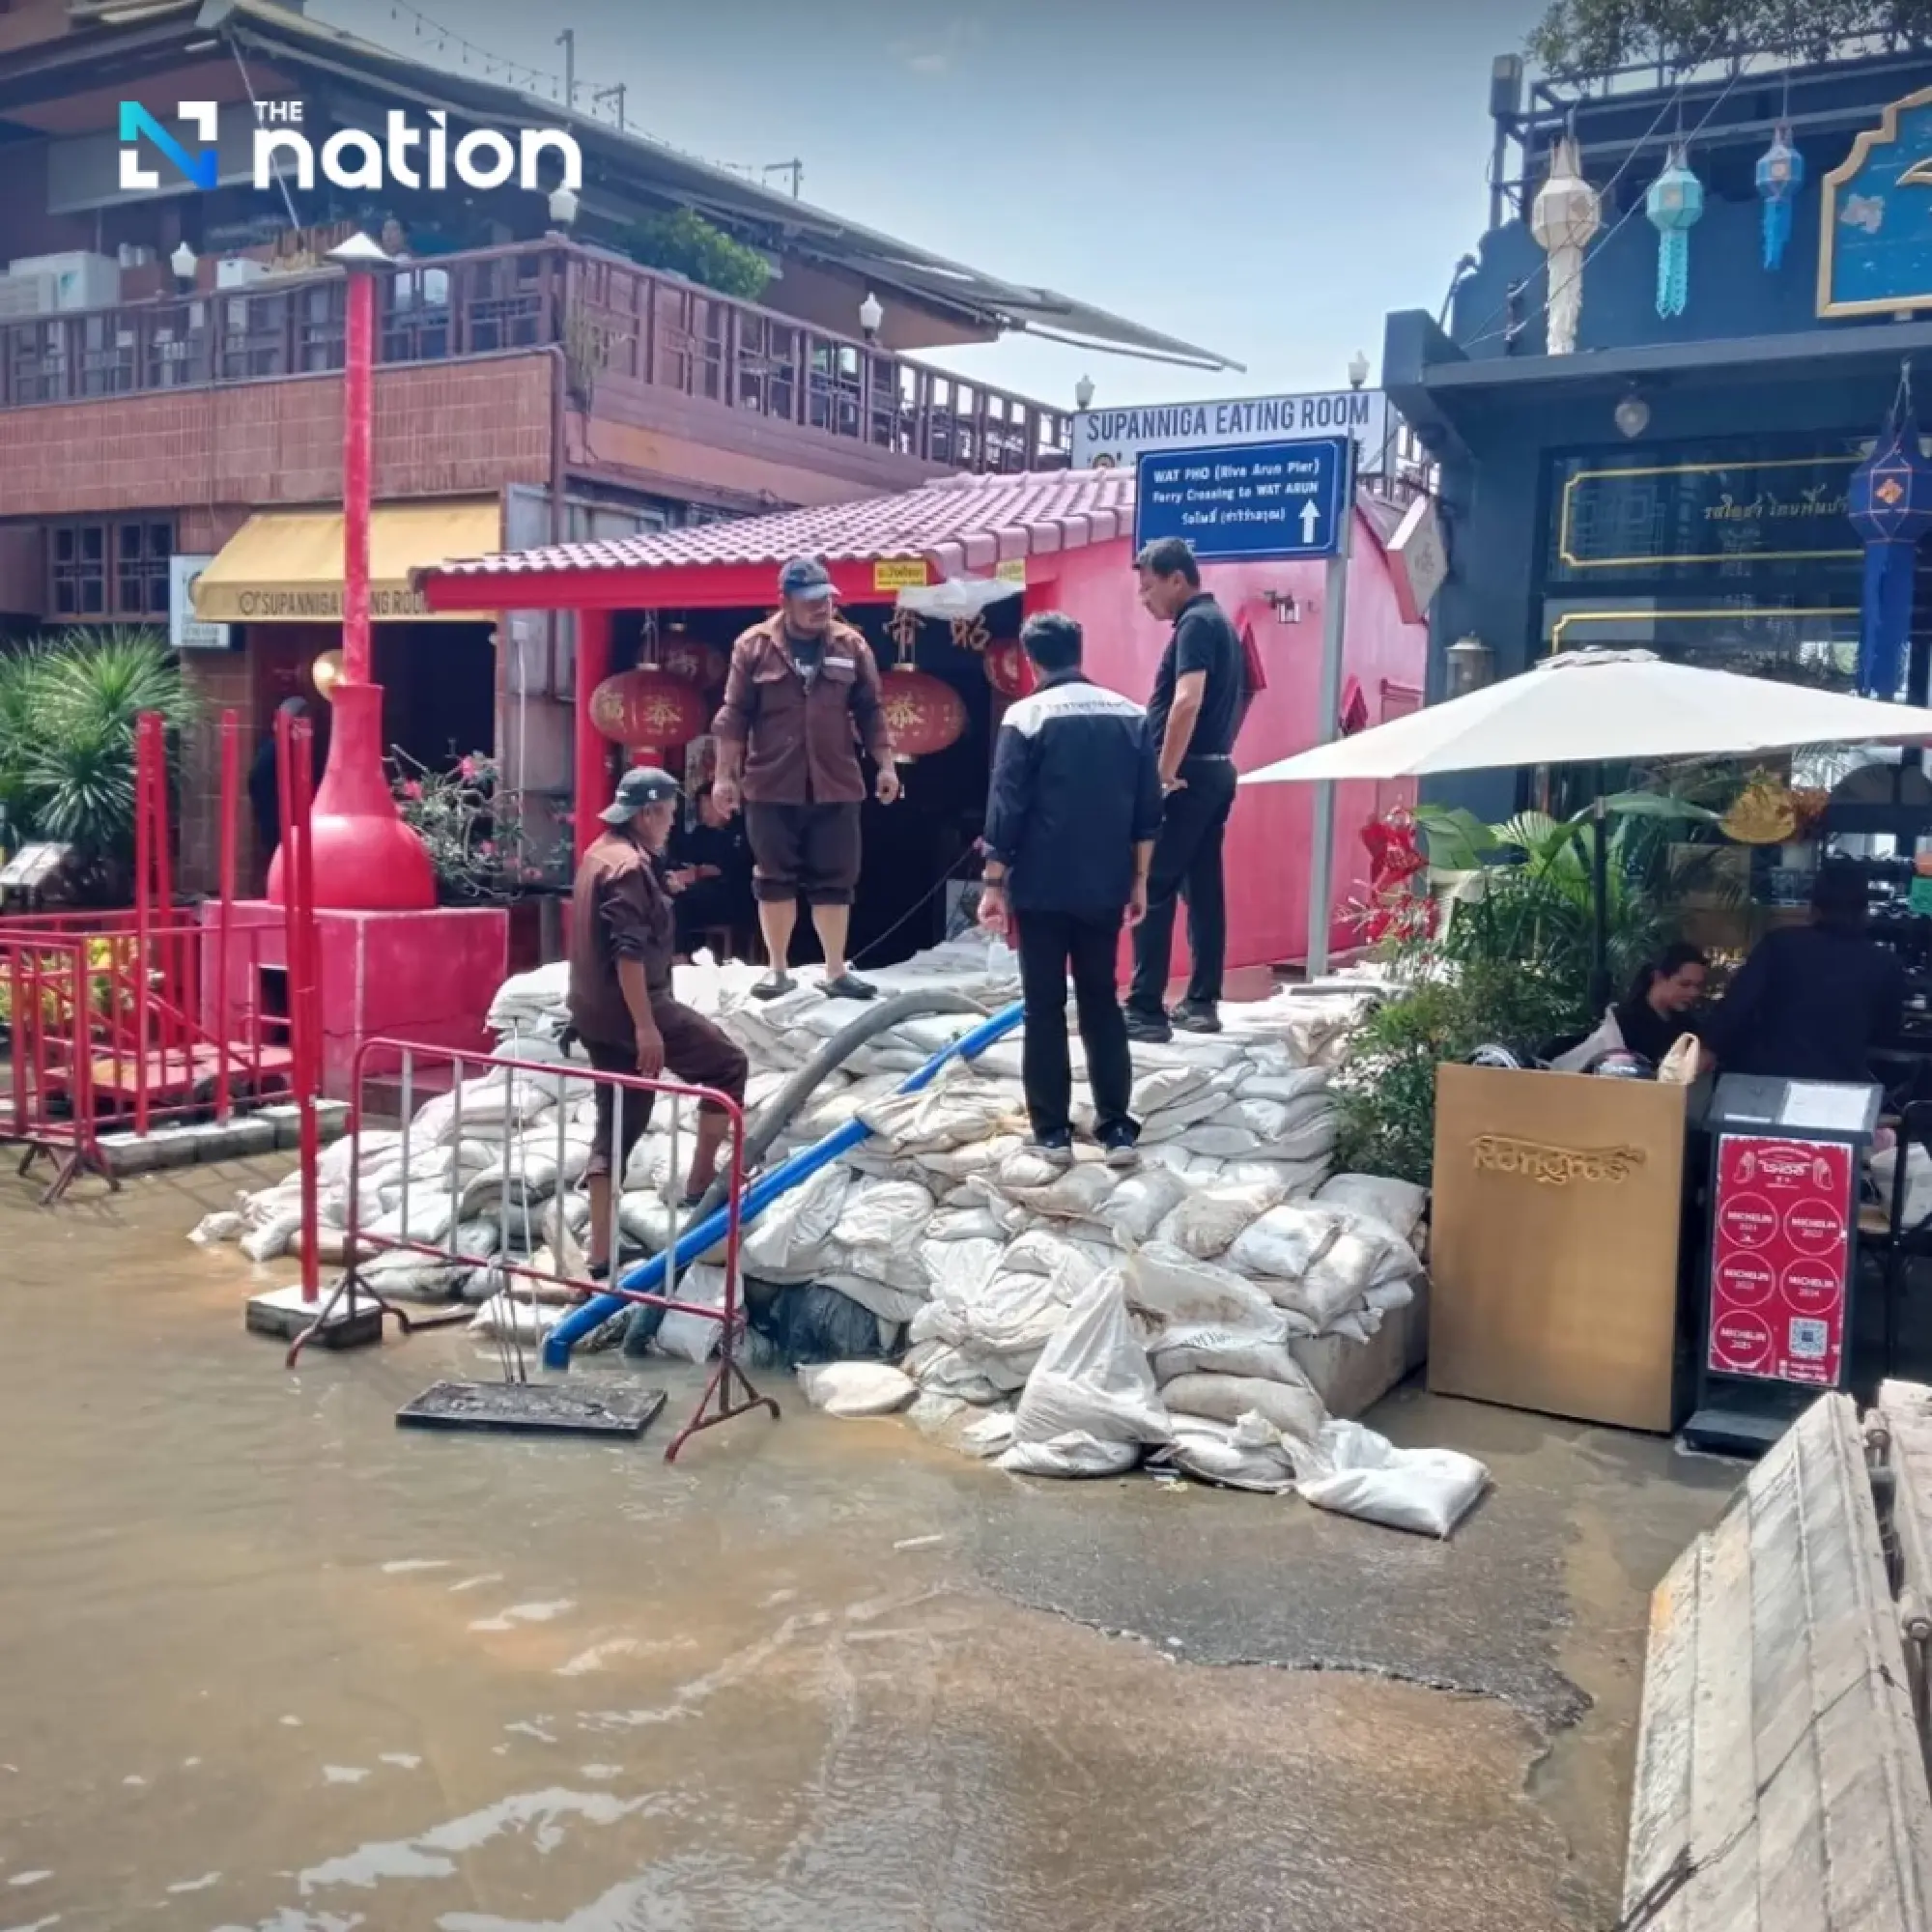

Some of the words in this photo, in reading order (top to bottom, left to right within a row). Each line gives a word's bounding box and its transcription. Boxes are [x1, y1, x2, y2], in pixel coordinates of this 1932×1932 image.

[1087, 406, 1207, 441] SUPANNIGA
[1215, 399, 1295, 435] EATING
[1300, 394, 1370, 428] ROOM
[1153, 469, 1180, 483] WAT
[1184, 467, 1209, 481] PHO
[1251, 464, 1282, 476] Arun
[1287, 457, 1321, 476] Pier)
[1152, 491, 1183, 504] Ferry
[1186, 487, 1235, 501] Crossing
[1238, 487, 1252, 498] to
[1256, 483, 1282, 496] WAT
[1285, 481, 1320, 495] ARUN
[262, 591, 338, 616] SUPANNIGA
[1727, 1210, 1773, 1224] MICHELIN
[1791, 1217, 1838, 1229] MICHELIN
[1723, 1267, 1769, 1282] MICHELIN
[1788, 1275, 1834, 1289] MICHELIN
[1719, 1327, 1766, 1343] MICHELIN
